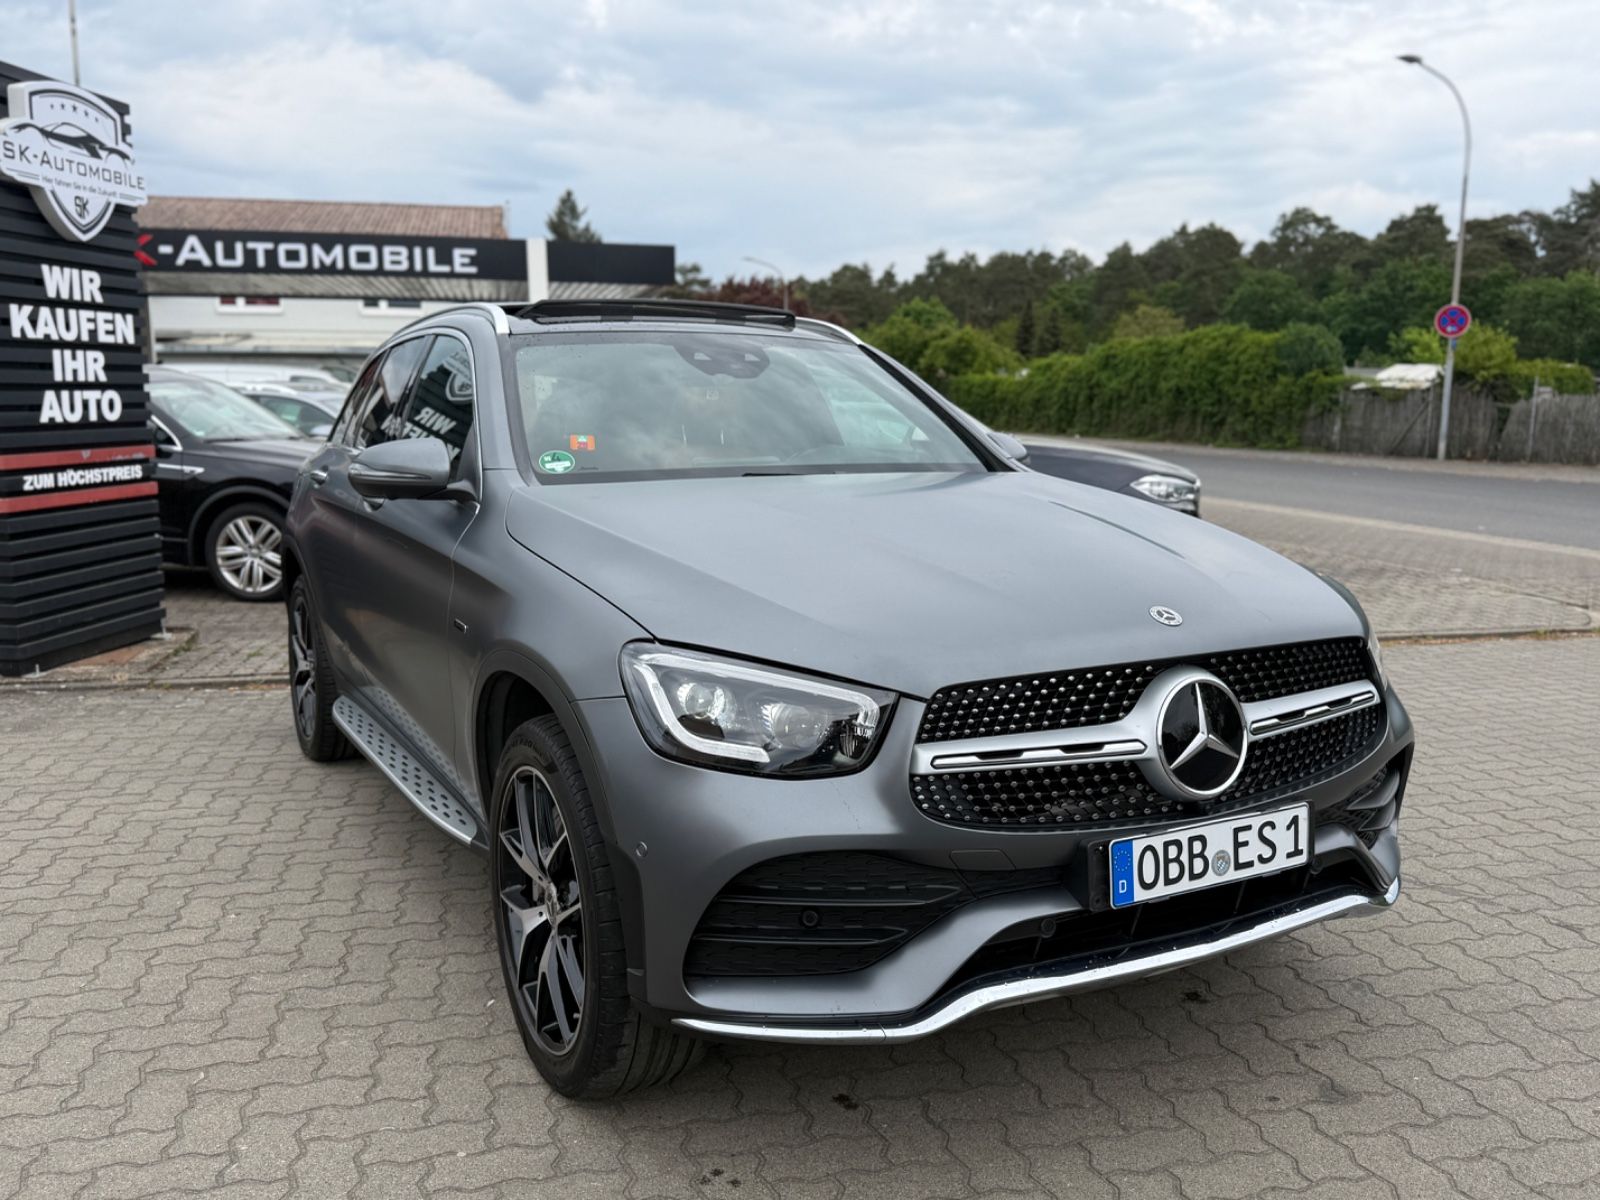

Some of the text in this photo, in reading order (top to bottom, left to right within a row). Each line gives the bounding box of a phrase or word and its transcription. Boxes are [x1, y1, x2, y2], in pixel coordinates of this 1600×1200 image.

[2, 140, 146, 190] SK-AUTOMOBILE
[40, 263, 104, 303] WIR
[9, 303, 136, 345] KAUFEN
[52, 349, 108, 382] IHR
[39, 389, 123, 423] AUTO
[22, 464, 144, 491] ZUM HÖCHSTPREIS
[1137, 834, 1210, 890] OBB
[1118, 879, 1127, 894] D
